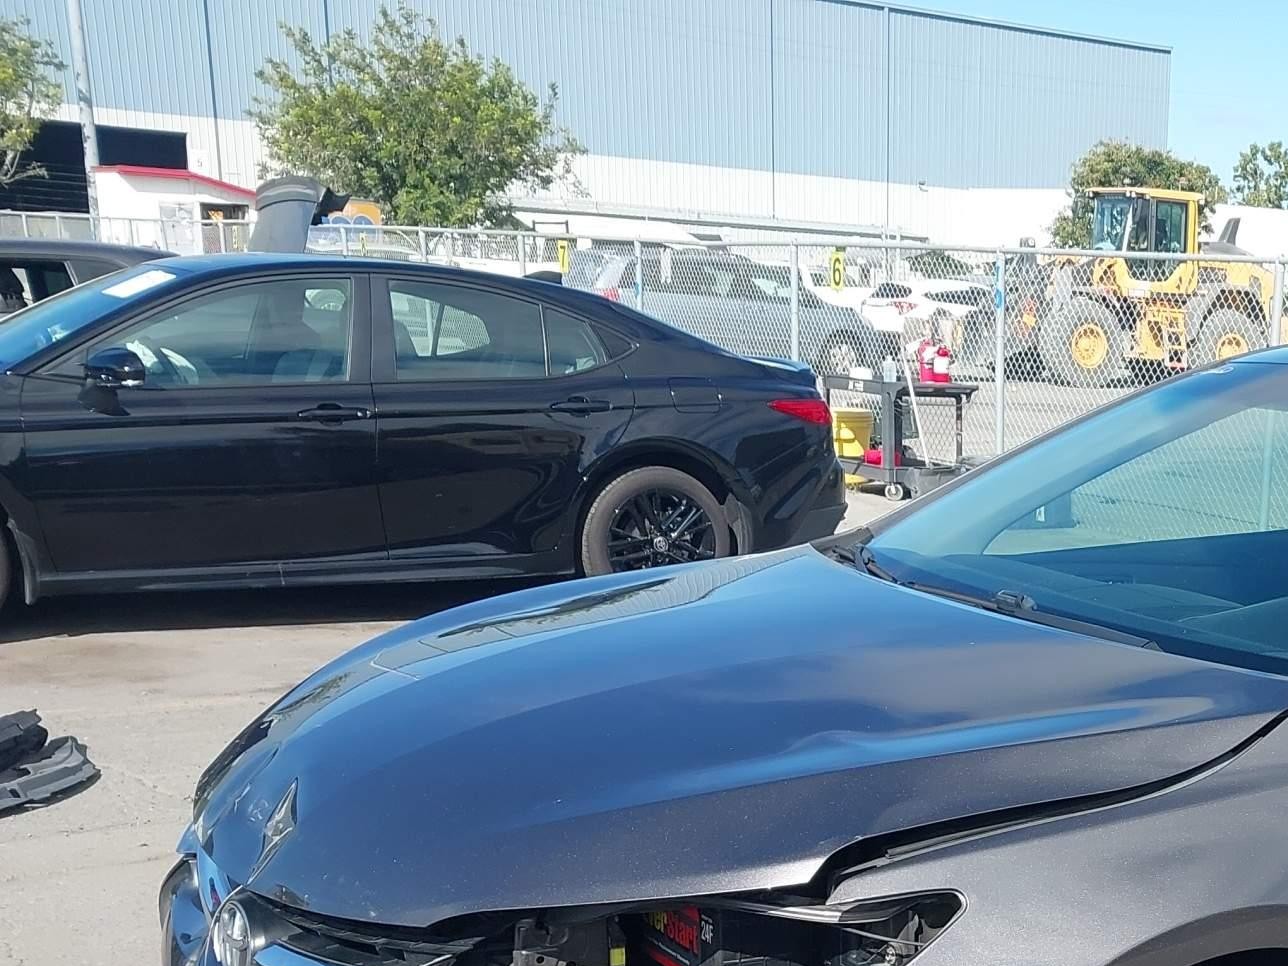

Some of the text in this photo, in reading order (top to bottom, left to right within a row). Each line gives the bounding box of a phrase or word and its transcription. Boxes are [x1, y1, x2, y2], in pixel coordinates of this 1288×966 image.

[560, 245, 567, 268] 7
[833, 258, 841, 286] 6
[701, 920, 714, 945] 24F
